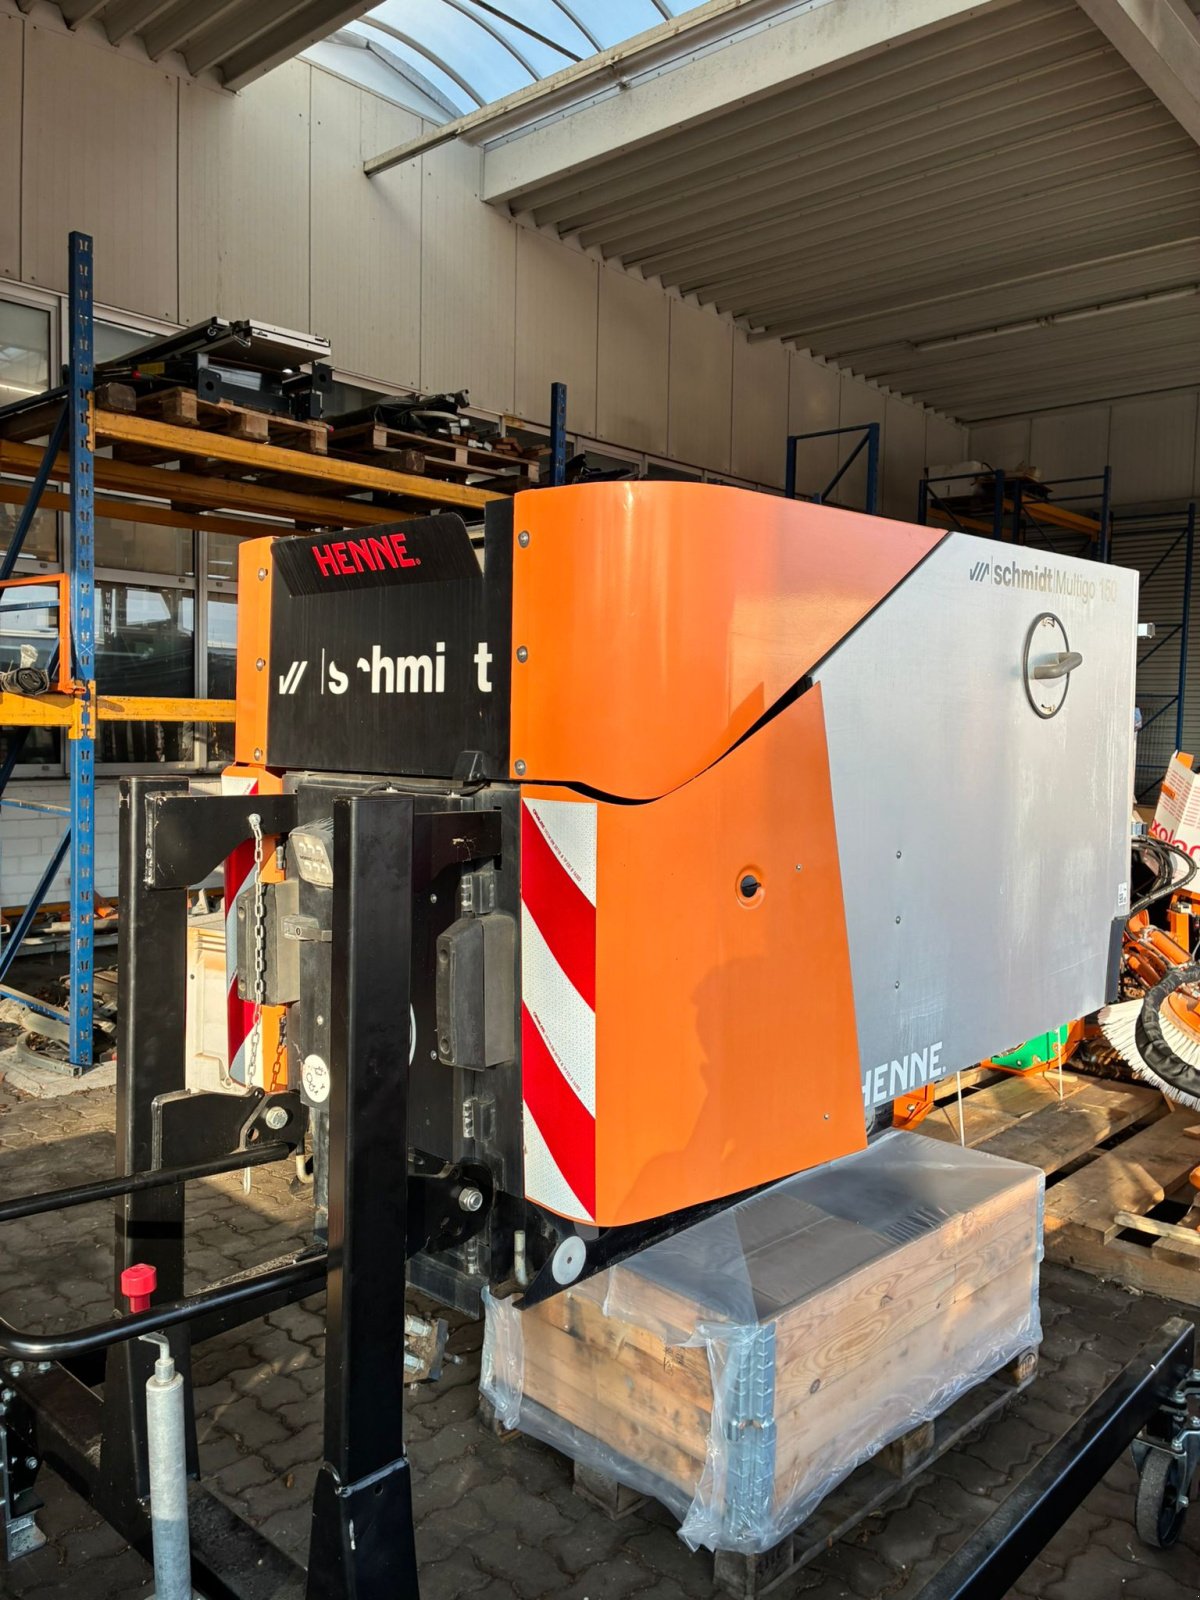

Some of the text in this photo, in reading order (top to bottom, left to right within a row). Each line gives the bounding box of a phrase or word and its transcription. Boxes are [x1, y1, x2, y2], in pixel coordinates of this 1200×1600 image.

[312, 533, 416, 576] HENNE
[994, 561, 1053, 593] schmidt
[1056, 570, 1096, 604] Multigo
[328, 641, 493, 695] shmit
